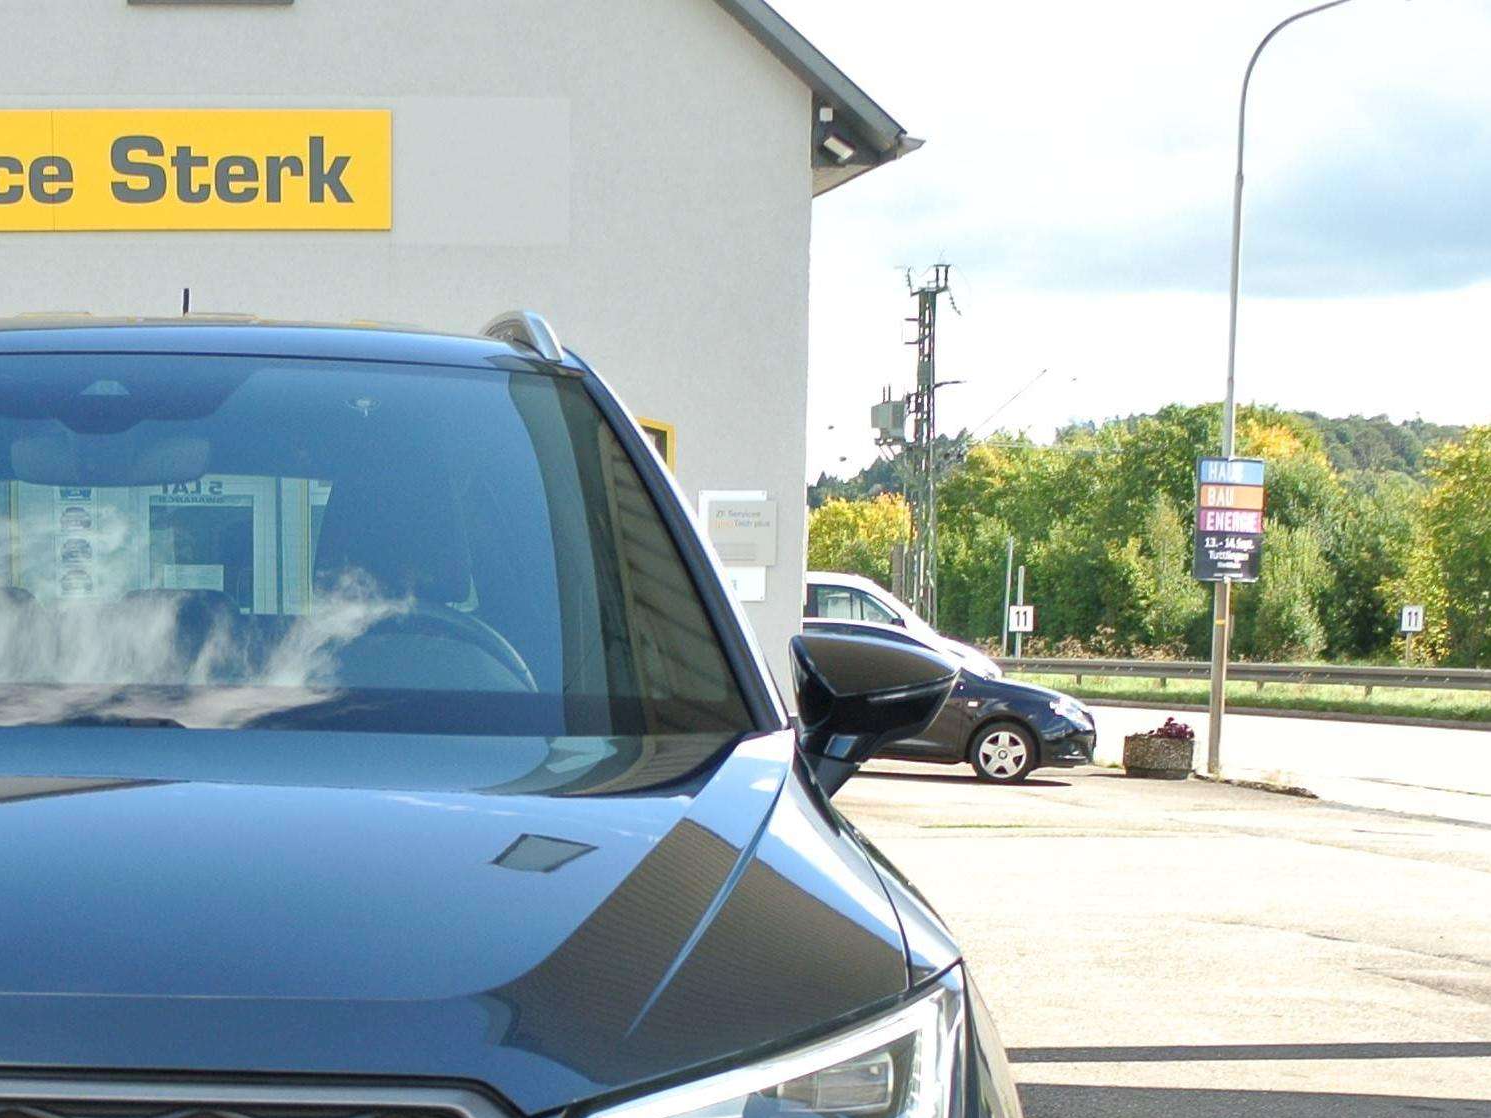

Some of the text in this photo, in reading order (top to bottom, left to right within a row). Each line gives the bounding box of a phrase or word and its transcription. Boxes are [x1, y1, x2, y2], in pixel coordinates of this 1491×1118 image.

[110, 135, 355, 204] Sterk
[1208, 486, 1235, 507] BAU
[1014, 610, 1027, 627] 11
[1408, 611, 1418, 627] 11
